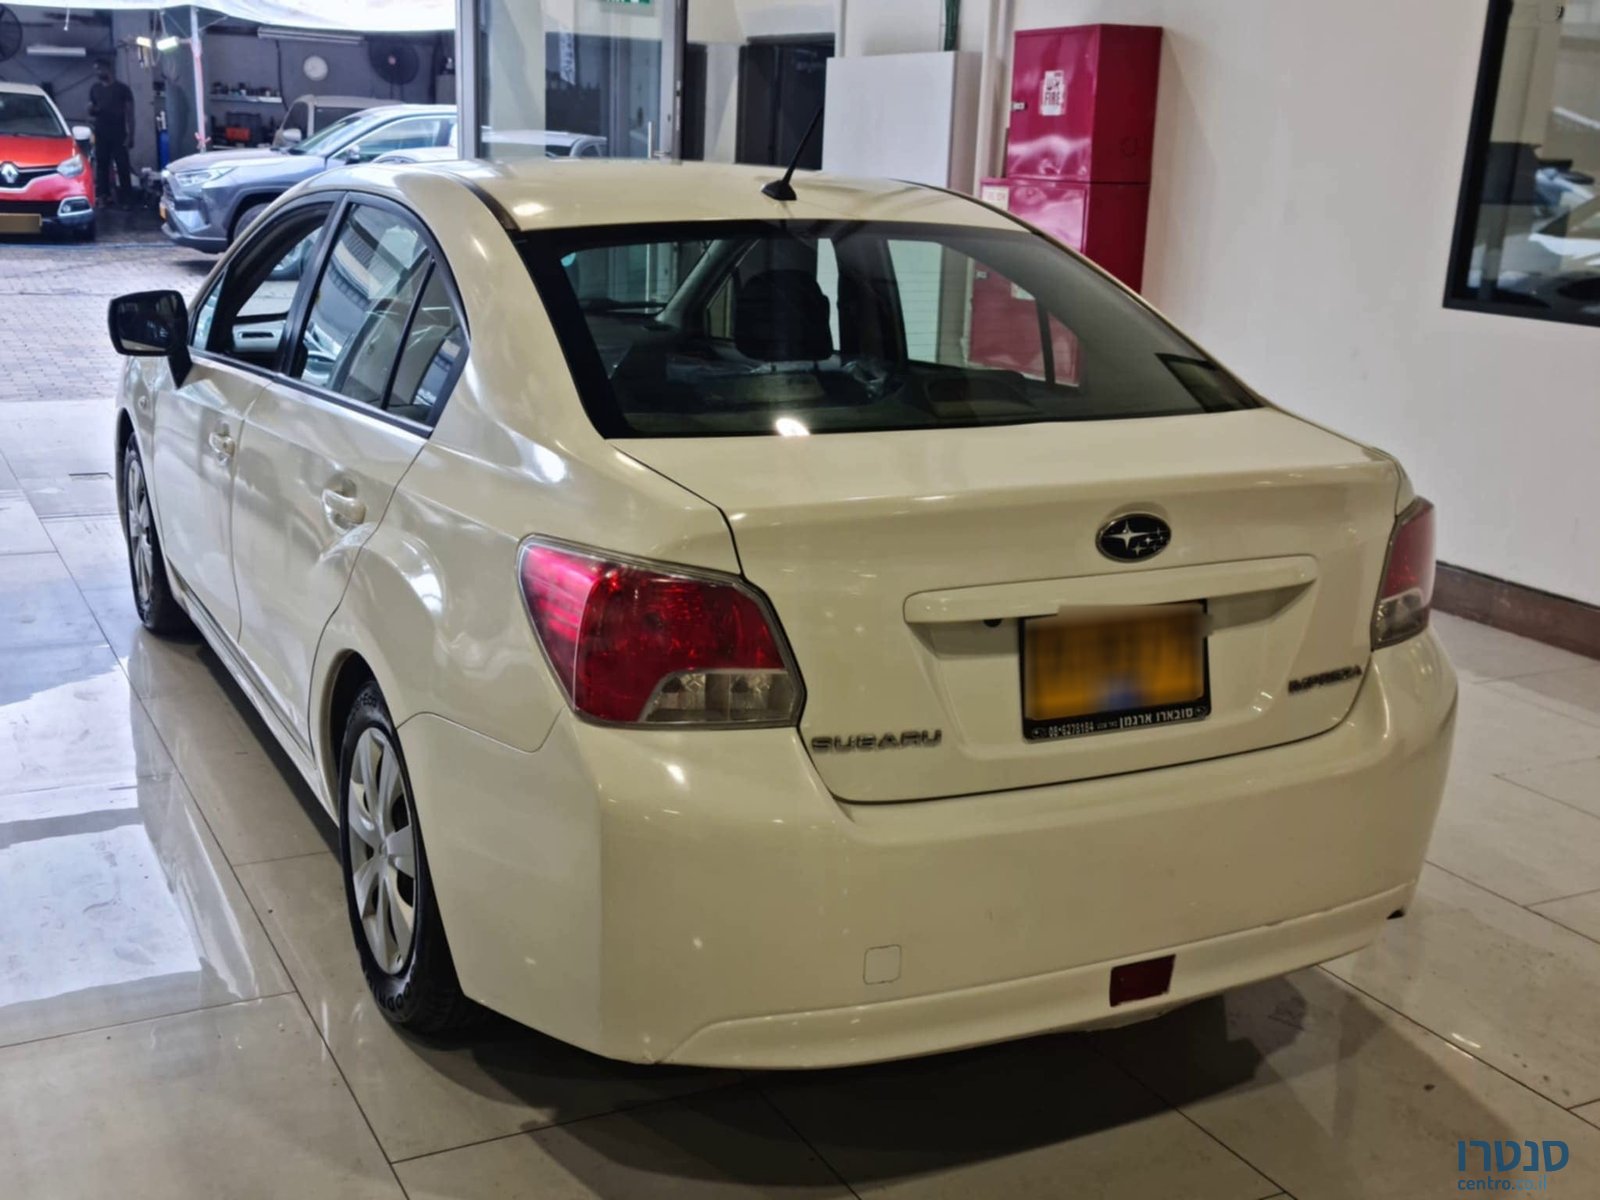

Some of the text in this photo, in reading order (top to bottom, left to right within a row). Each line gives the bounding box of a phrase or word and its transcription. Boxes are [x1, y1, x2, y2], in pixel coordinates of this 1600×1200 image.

[1120, 713, 1152, 729] ארגמן
[1156, 707, 1193, 722] סובארו
[811, 729, 942, 752] SUBARU
